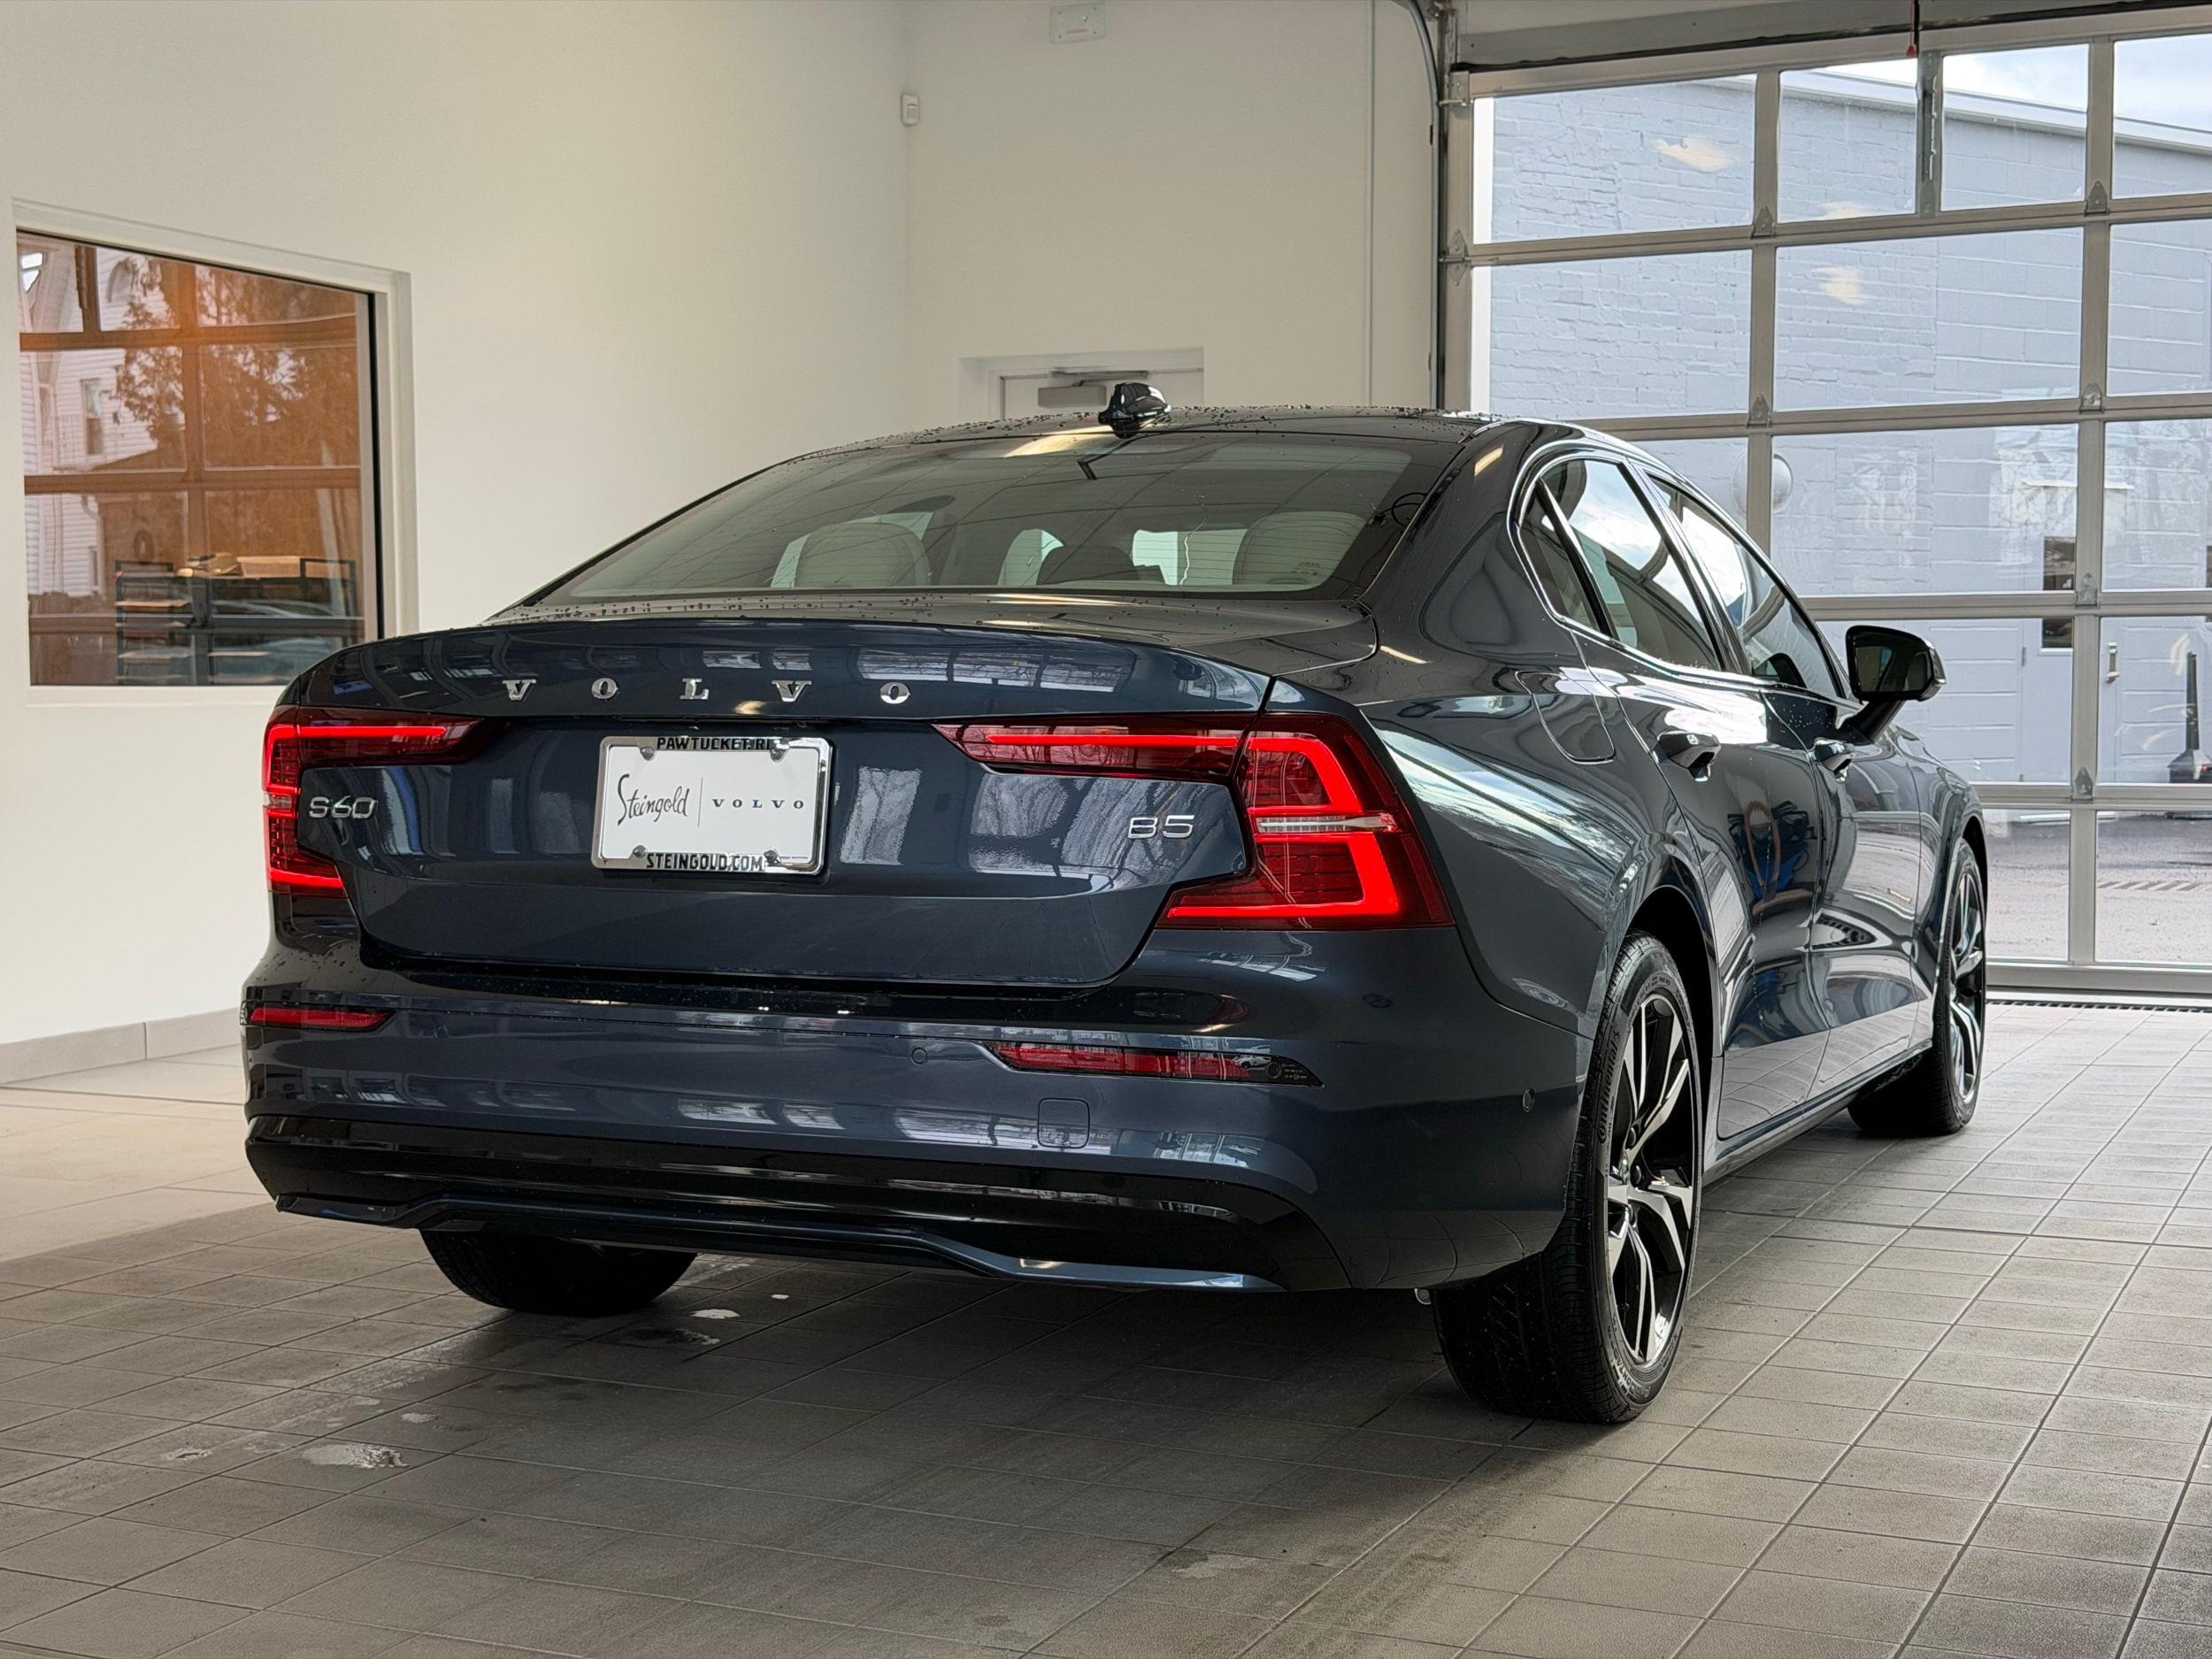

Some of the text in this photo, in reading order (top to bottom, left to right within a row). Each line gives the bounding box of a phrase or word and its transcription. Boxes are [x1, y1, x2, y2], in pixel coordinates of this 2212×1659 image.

[502, 678, 910, 704] VOLVO
[309, 795, 377, 818] S60
[617, 773, 804, 826] Steingold VOLVO
[1128, 815, 1194, 838] B5
[646, 853, 764, 872] STEINGOLD.COM
[1597, 1041, 1618, 1144] Continental
